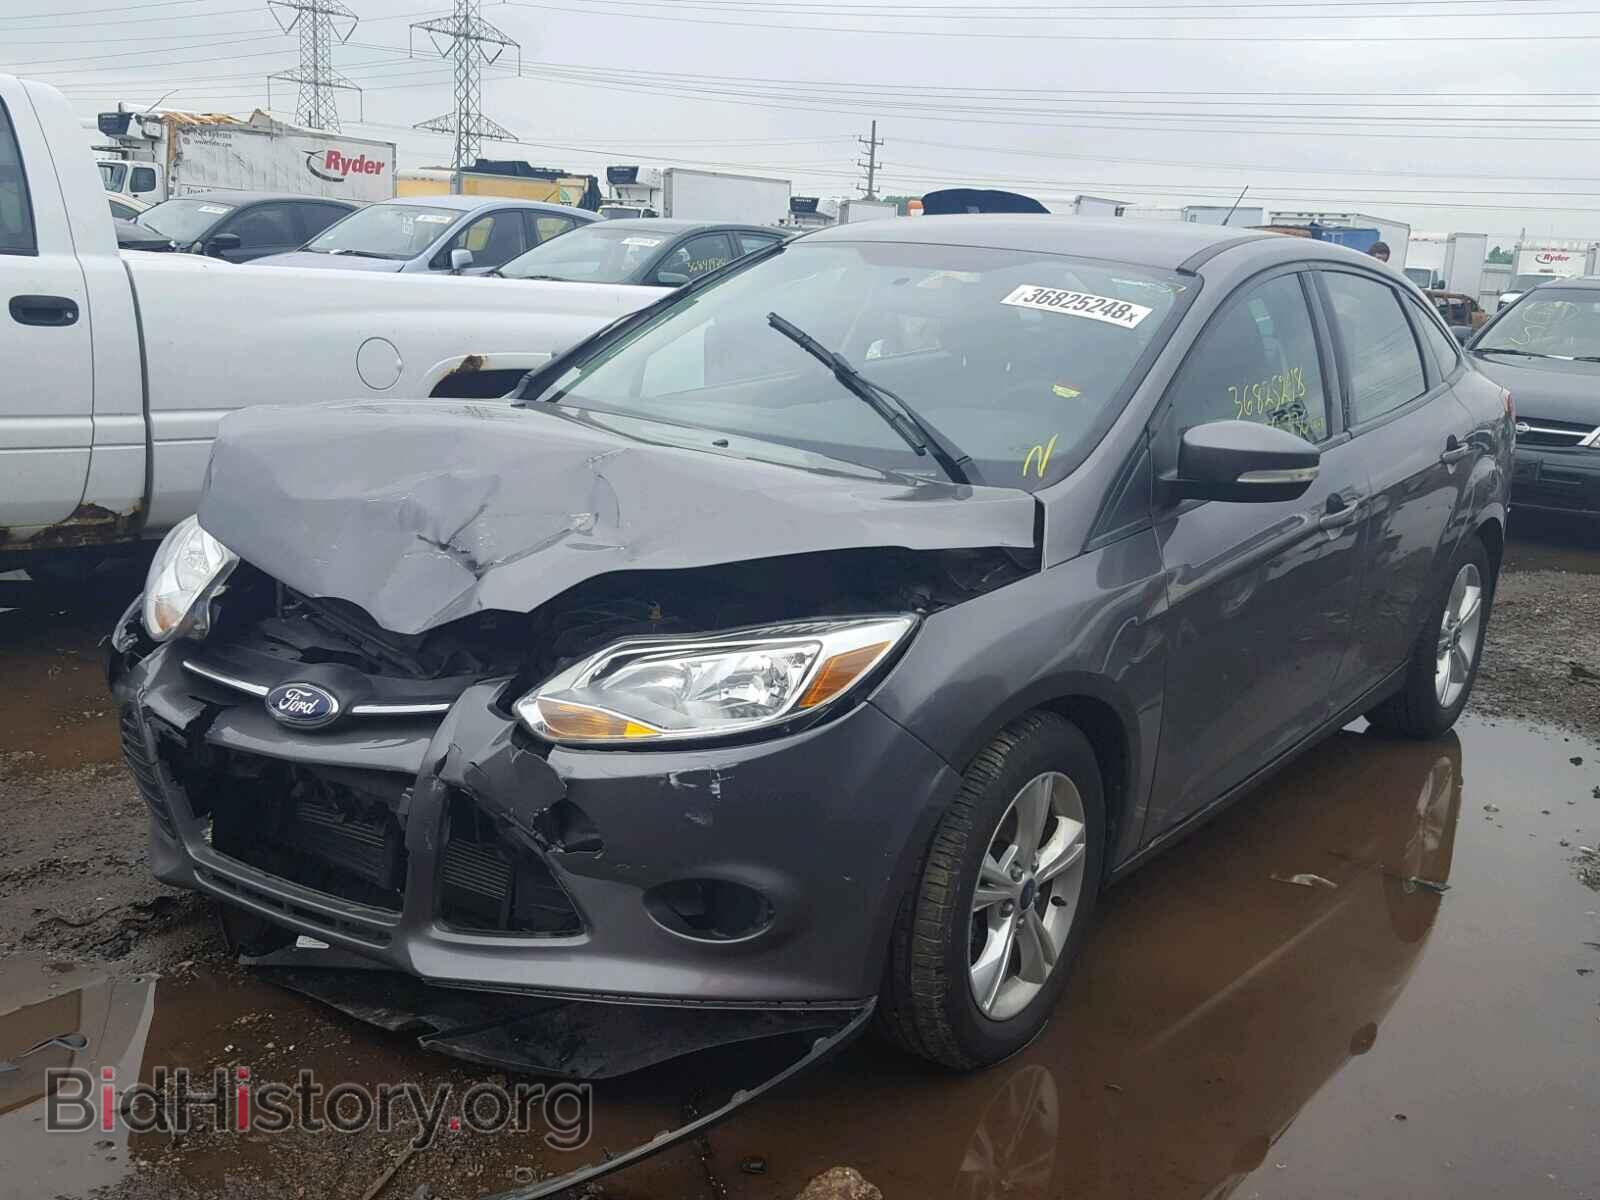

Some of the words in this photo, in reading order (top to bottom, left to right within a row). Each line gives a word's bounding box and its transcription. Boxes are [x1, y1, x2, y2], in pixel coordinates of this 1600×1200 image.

[325, 150, 385, 176] Ryder
[1543, 253, 1570, 263] Ryder
[279, 688, 320, 715] Ford
